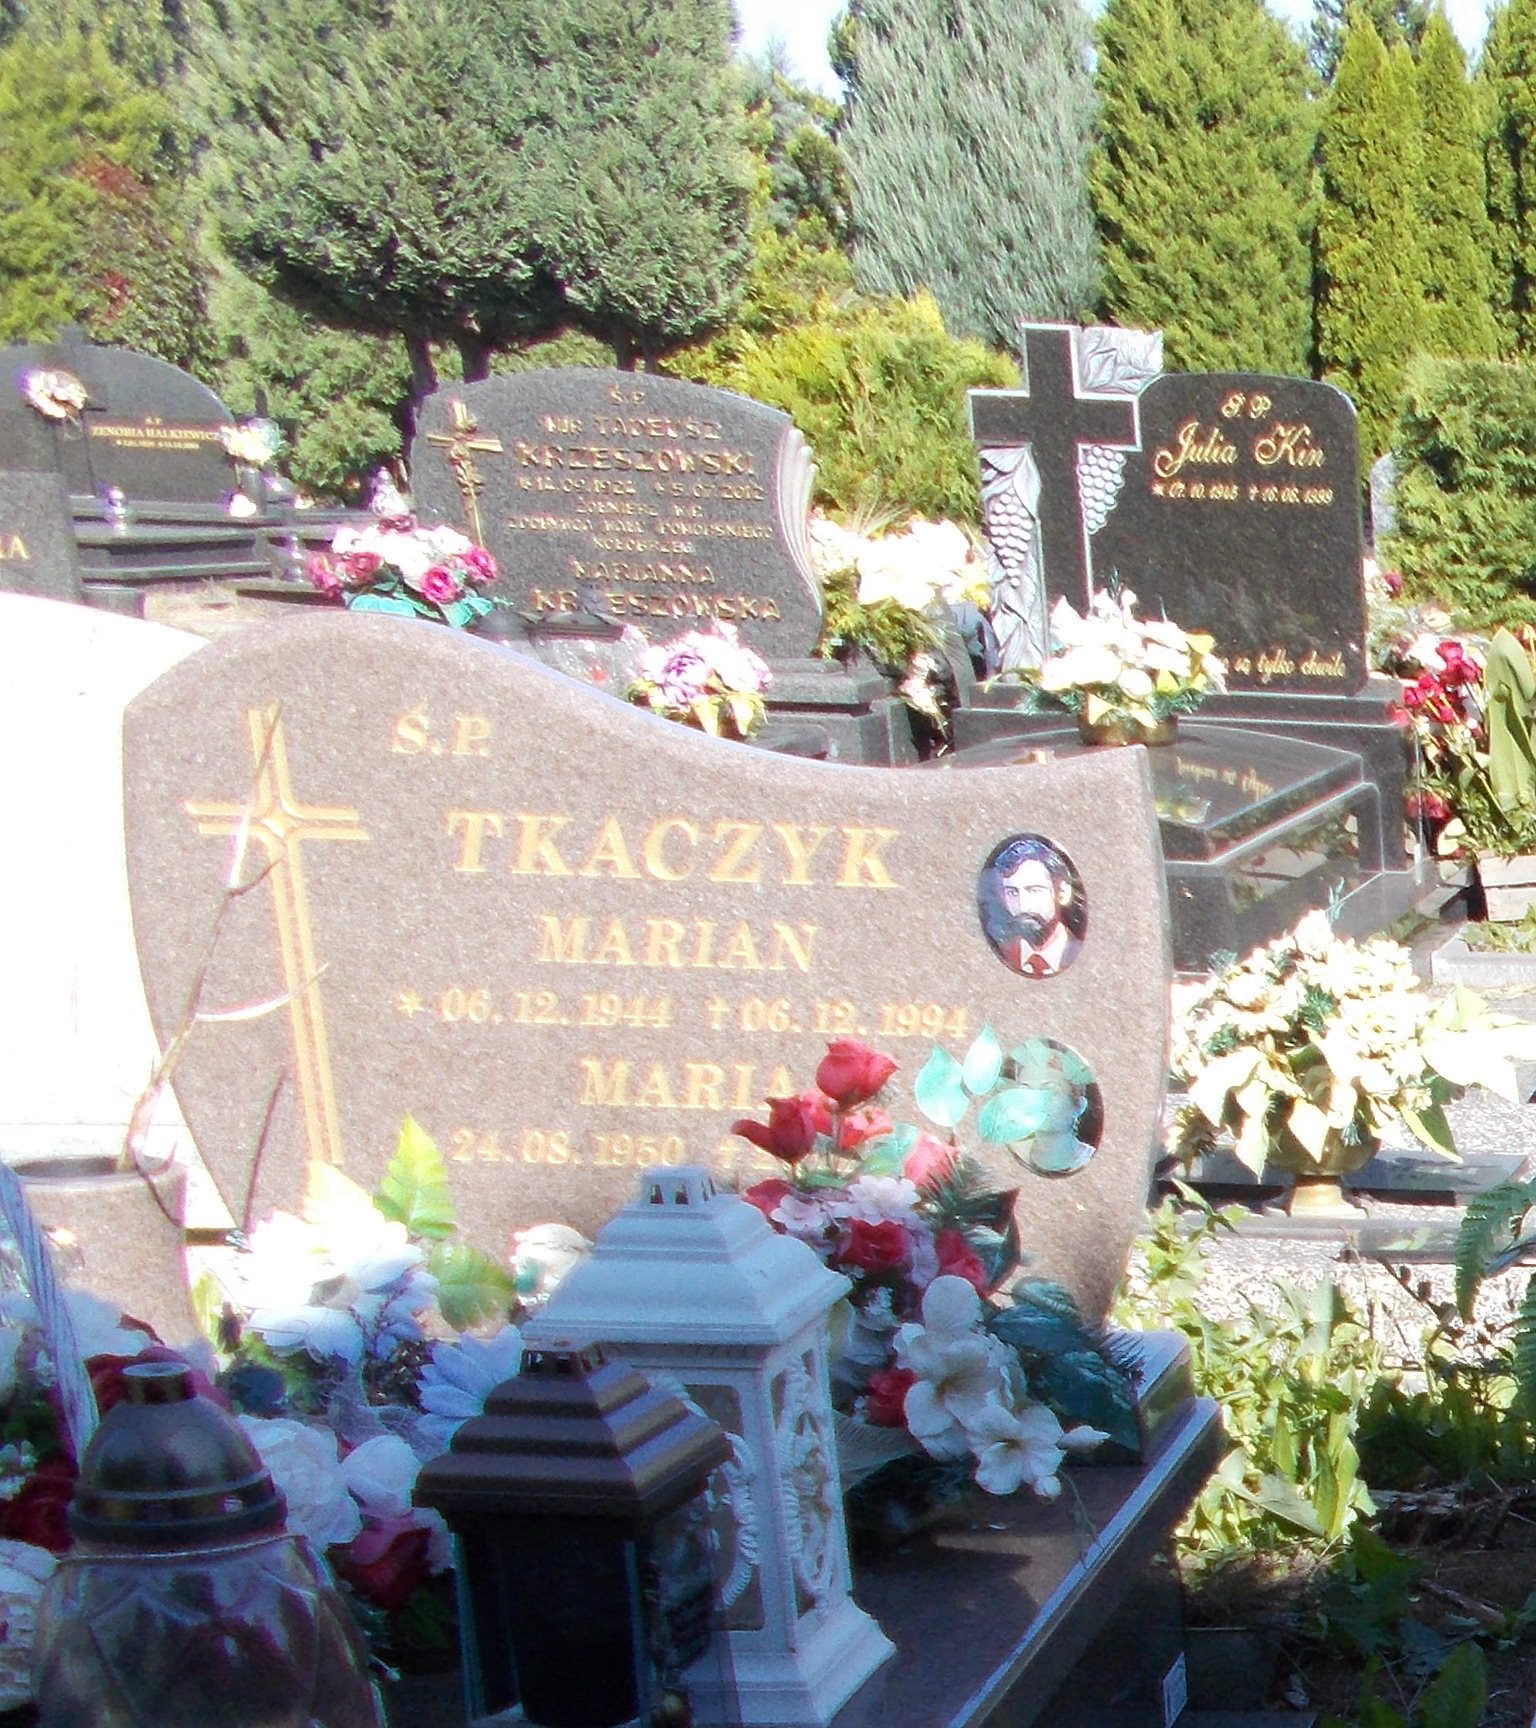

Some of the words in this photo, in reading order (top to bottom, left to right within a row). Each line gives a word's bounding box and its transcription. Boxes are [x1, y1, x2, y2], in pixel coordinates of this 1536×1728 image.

[91, 426, 144, 437] ZENOBIA
[594, 416, 721, 440] TADEUSZ
[515, 440, 756, 476] KRZESZOWSKI
[1154, 421, 1238, 478] Julia
[1255, 423, 1326, 468] Kin
[571, 557, 716, 585] MARIANNA
[533, 587, 781, 621] KRESZOWSKA
[446, 807, 901, 890] TKACZYK
[536, 913, 819, 973] MARIAN
[580, 1055, 797, 1112] MARIA
